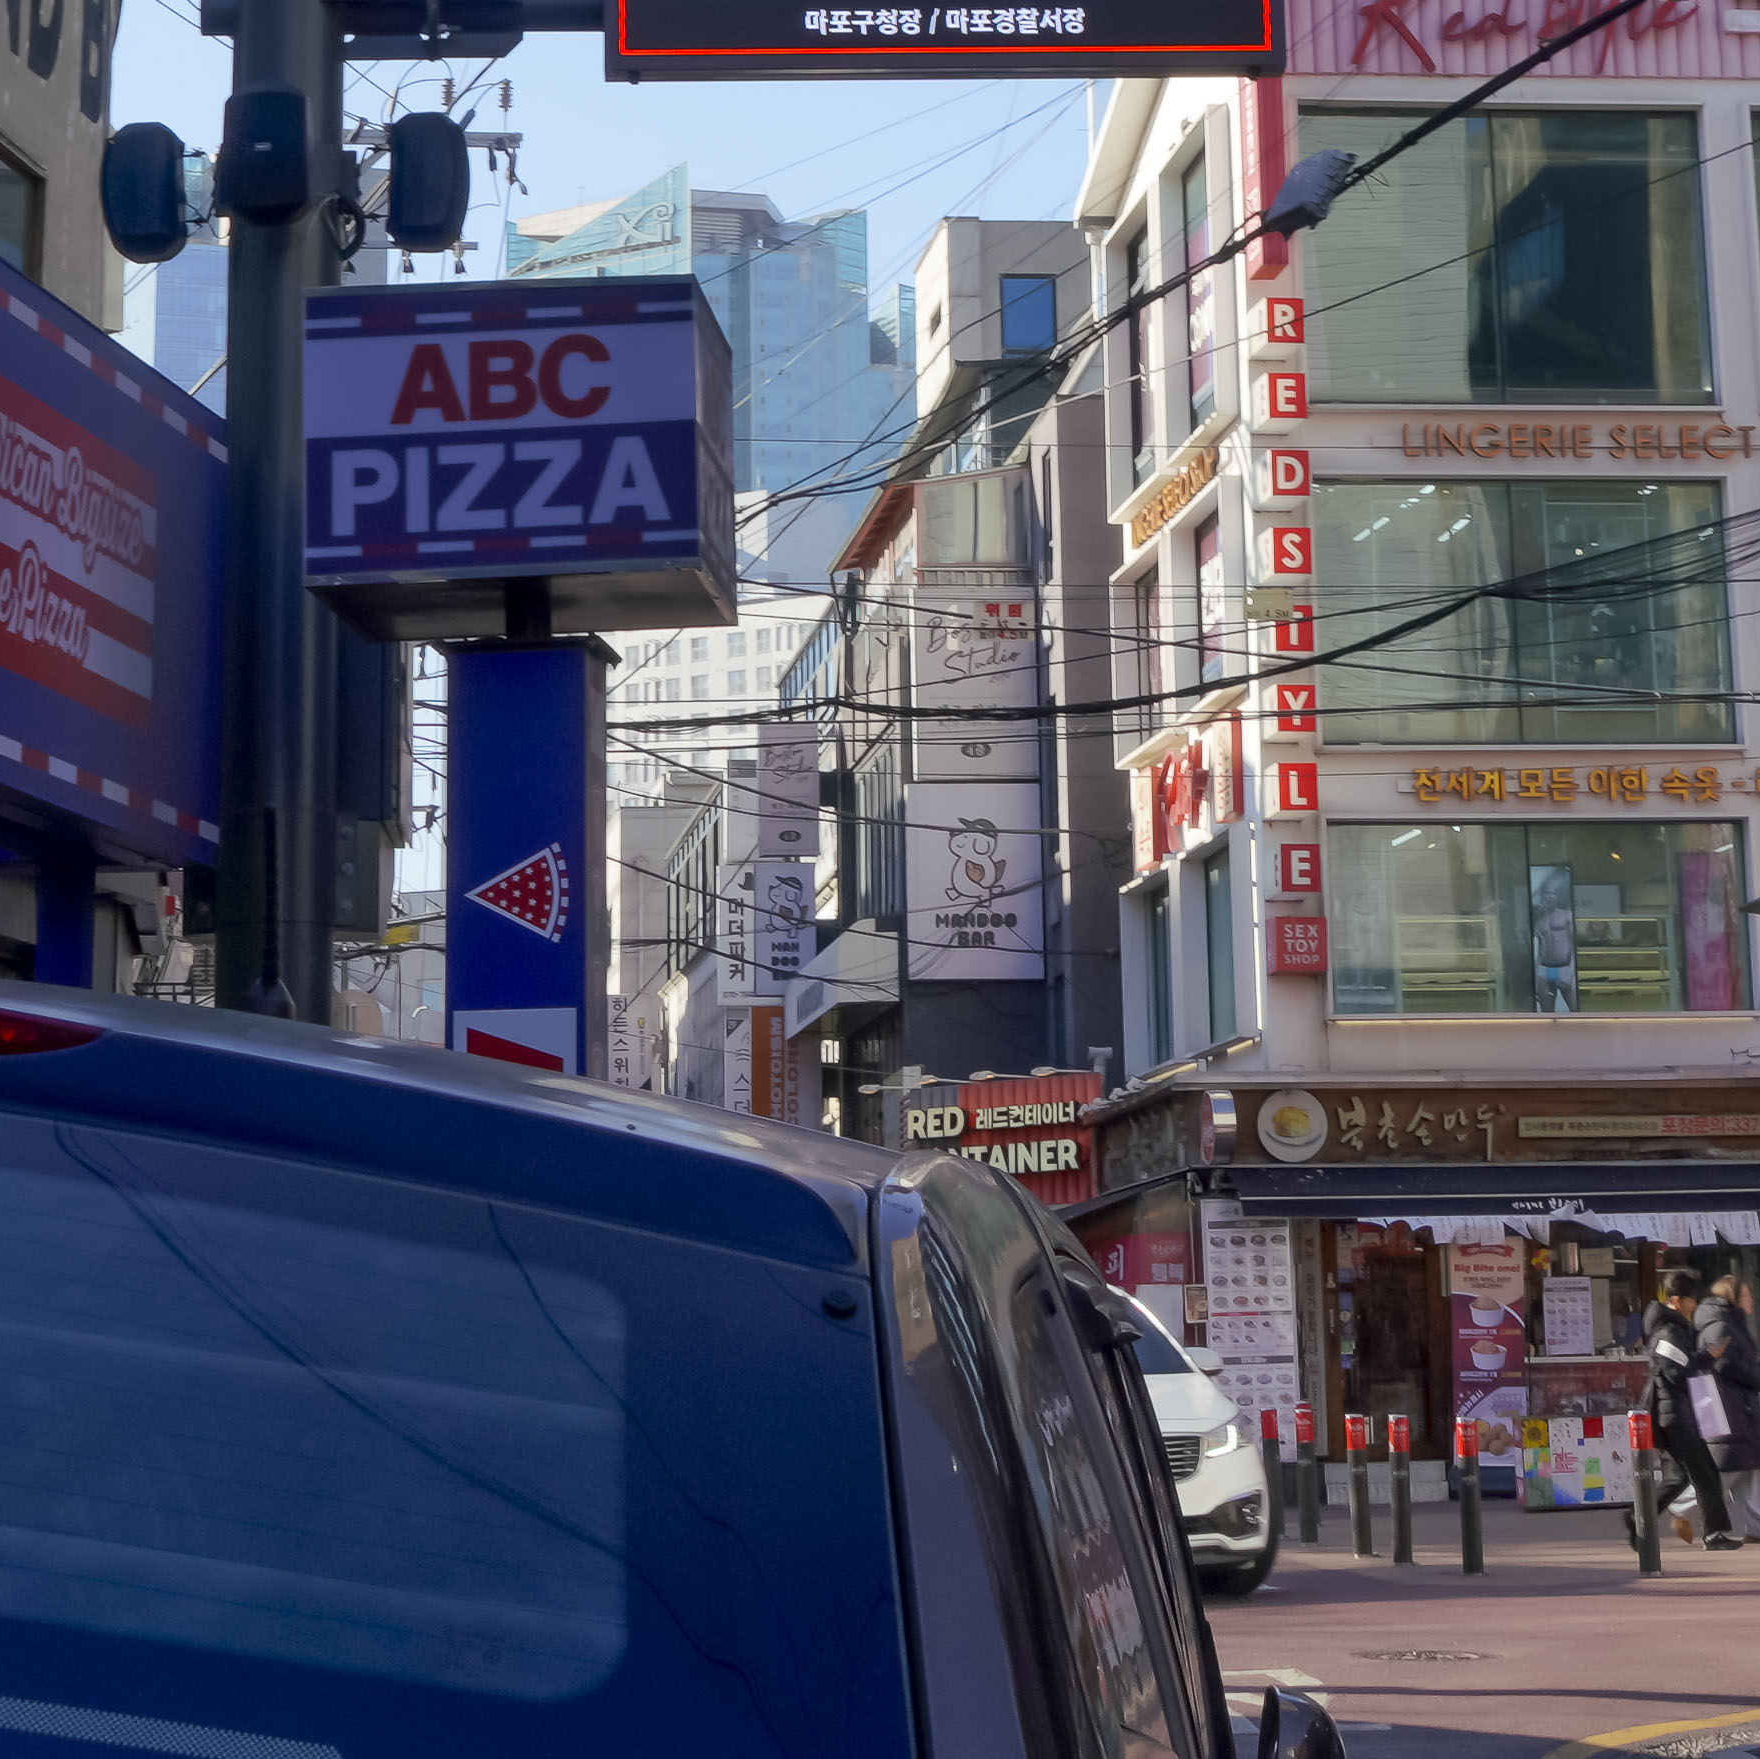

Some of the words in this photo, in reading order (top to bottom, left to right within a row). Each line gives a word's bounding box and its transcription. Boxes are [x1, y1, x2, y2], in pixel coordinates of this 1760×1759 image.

[804, 7, 922, 36] 마포구청장
[945, 6, 1086, 35] 마포경찰서장
[390, 333, 612, 427] ABC
[1401, 422, 1593, 460] LINGERIE
[1607, 424, 1756, 461] SELECT
[329, 435, 672, 539] PIZZA
[1413, 767, 1508, 803] 전세계
[1517, 767, 1580, 803] 모든
[1587, 766, 1649, 802] 야한
[1660, 766, 1725, 803] 속옷
[935, 912, 1018, 929] MANDOO
[1283, 923, 1319, 939] SEX
[956, 930, 996, 946] BAR
[1284, 939, 1319, 954] TOY
[1283, 953, 1321, 966] SHOP
[906, 1105, 965, 1140] RED
[974, 1100, 1076, 1131] 레드컨테이너
[1453, 1263, 1471, 1275] Big
[1472, 1262, 1495, 1274] Bite
